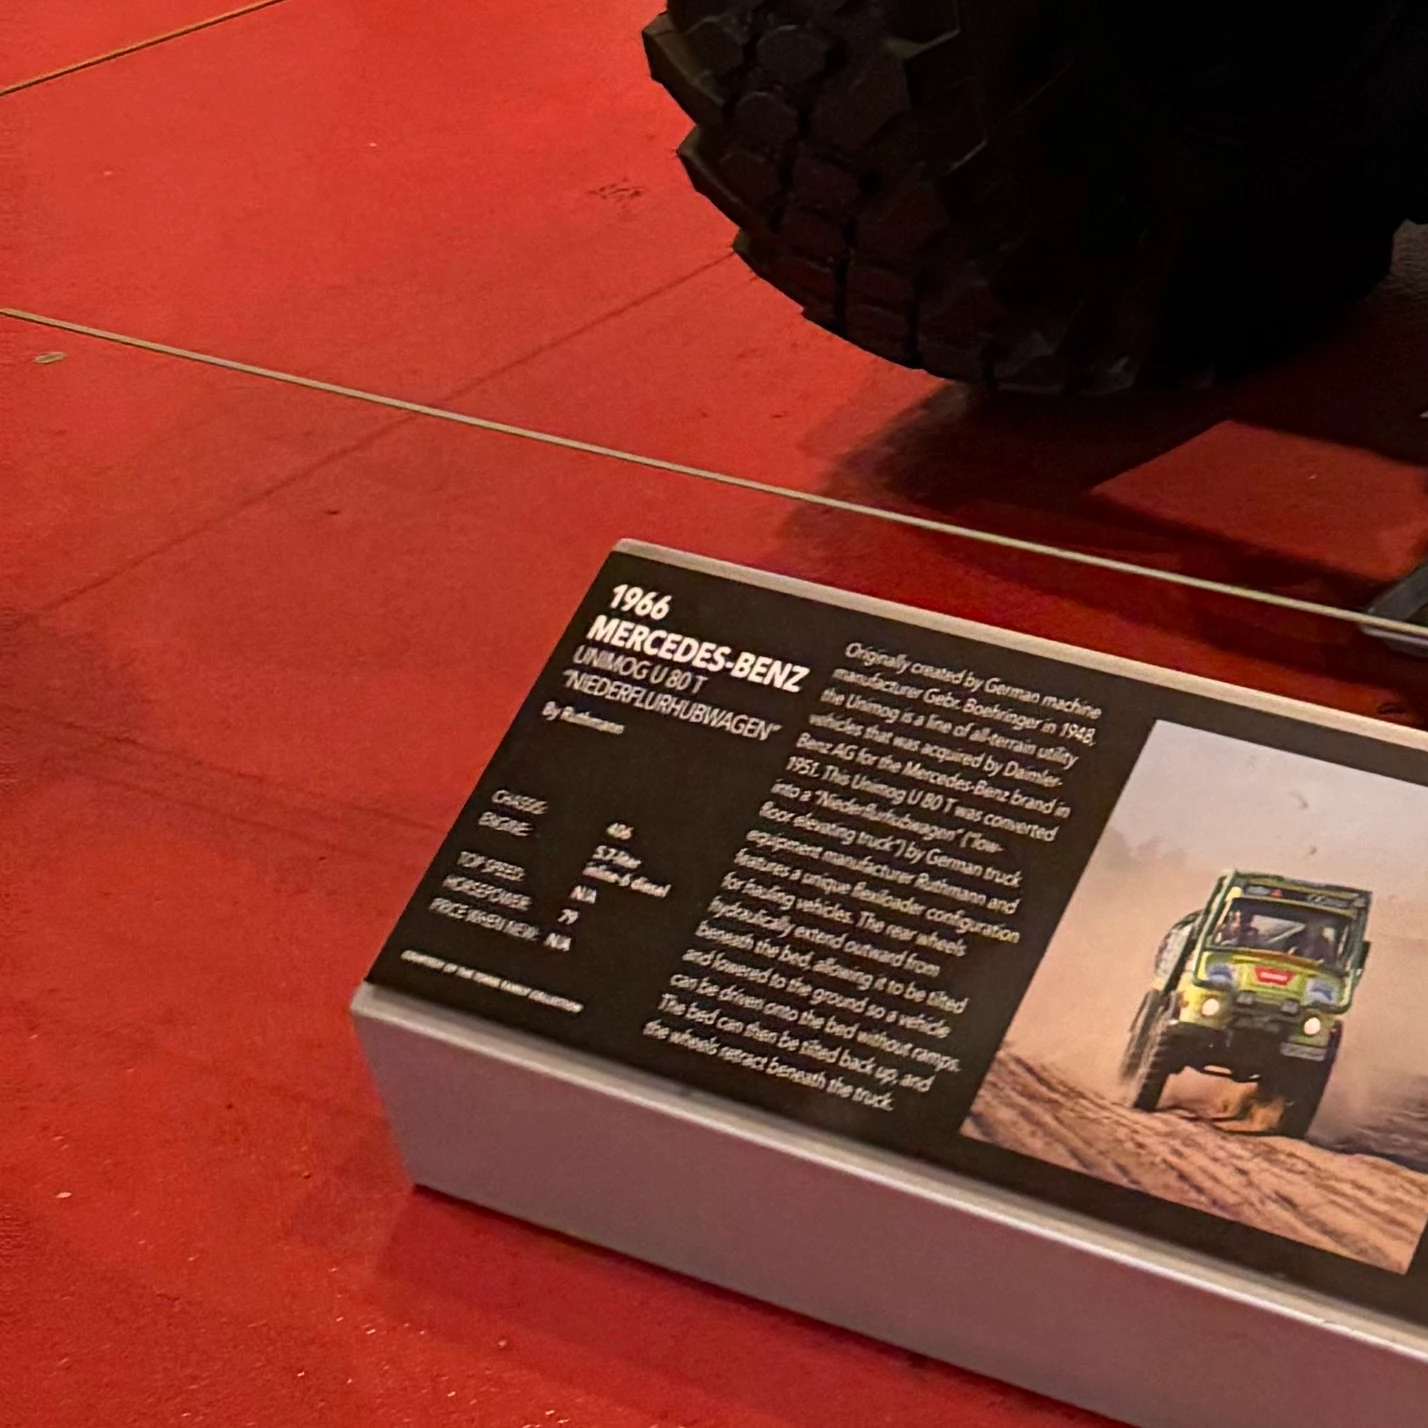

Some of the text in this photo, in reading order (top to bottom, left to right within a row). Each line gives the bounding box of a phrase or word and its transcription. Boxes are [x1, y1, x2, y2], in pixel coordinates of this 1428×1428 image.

[610, 584, 672, 621] 1966
[573, 644, 709, 694] UNIMOG U 80 T
[586, 614, 810, 693] MERCEDES-BENZ
[845, 642, 1102, 720] Originally created by German machine
[542, 700, 562, 721] By
[820, 687, 1080, 771] the Unimog is a line of all-terrain utility
[832, 668, 924, 699] manufacturer
[962, 697, 1044, 731] Boehringer
[1040, 718, 1057, 734] in
[1059, 722, 1096, 747] 1948,
[796, 732, 1071, 818] Benz AG for the Mercedes-Benz brand in
[809, 712, 1063, 788] vehicles that was acquired by Daimler-
[770, 778, 801, 799] into
[799, 790, 812, 802] a
[785, 756, 1060, 842] 1951. This Unimog U 80 T was converted
[457, 851, 486, 868] TOP
[570, 885, 597, 904] N/A
[746, 829, 824, 859] equipment
[821, 850, 917, 885] manufacturer
[986, 897, 1021, 915] and
[759, 800, 796, 823] floor
[792, 812, 857, 846] elevating
[903, 841, 927, 865] by
[925, 848, 984, 877] German
[982, 866, 1023, 888] truck
[557, 908, 579, 925] 79
[630, 876, 672, 898] diesel
[721, 871, 967, 957] for hauling vehicles. The rear wheels
[733, 847, 791, 878] features
[789, 869, 802, 881] a
[801, 872, 852, 895] unique
[925, 907, 1020, 944] configuration
[544, 932, 572, 952] N/A
[694, 919, 970, 1015] beneath the bed, allowing it to be tilted
[793, 925, 848, 949] extend
[843, 940, 909, 967] outward
[903, 952, 941, 977] from
[670, 973, 961, 1073] can be driven onto the bed without ramps.
[682, 948, 952, 1039] and lowered to the ground so a vehicle
[643, 1019, 894, 1111] the wheels retract beneath the truck.
[658, 993, 936, 1093] The bed can then be tilted back up, and
